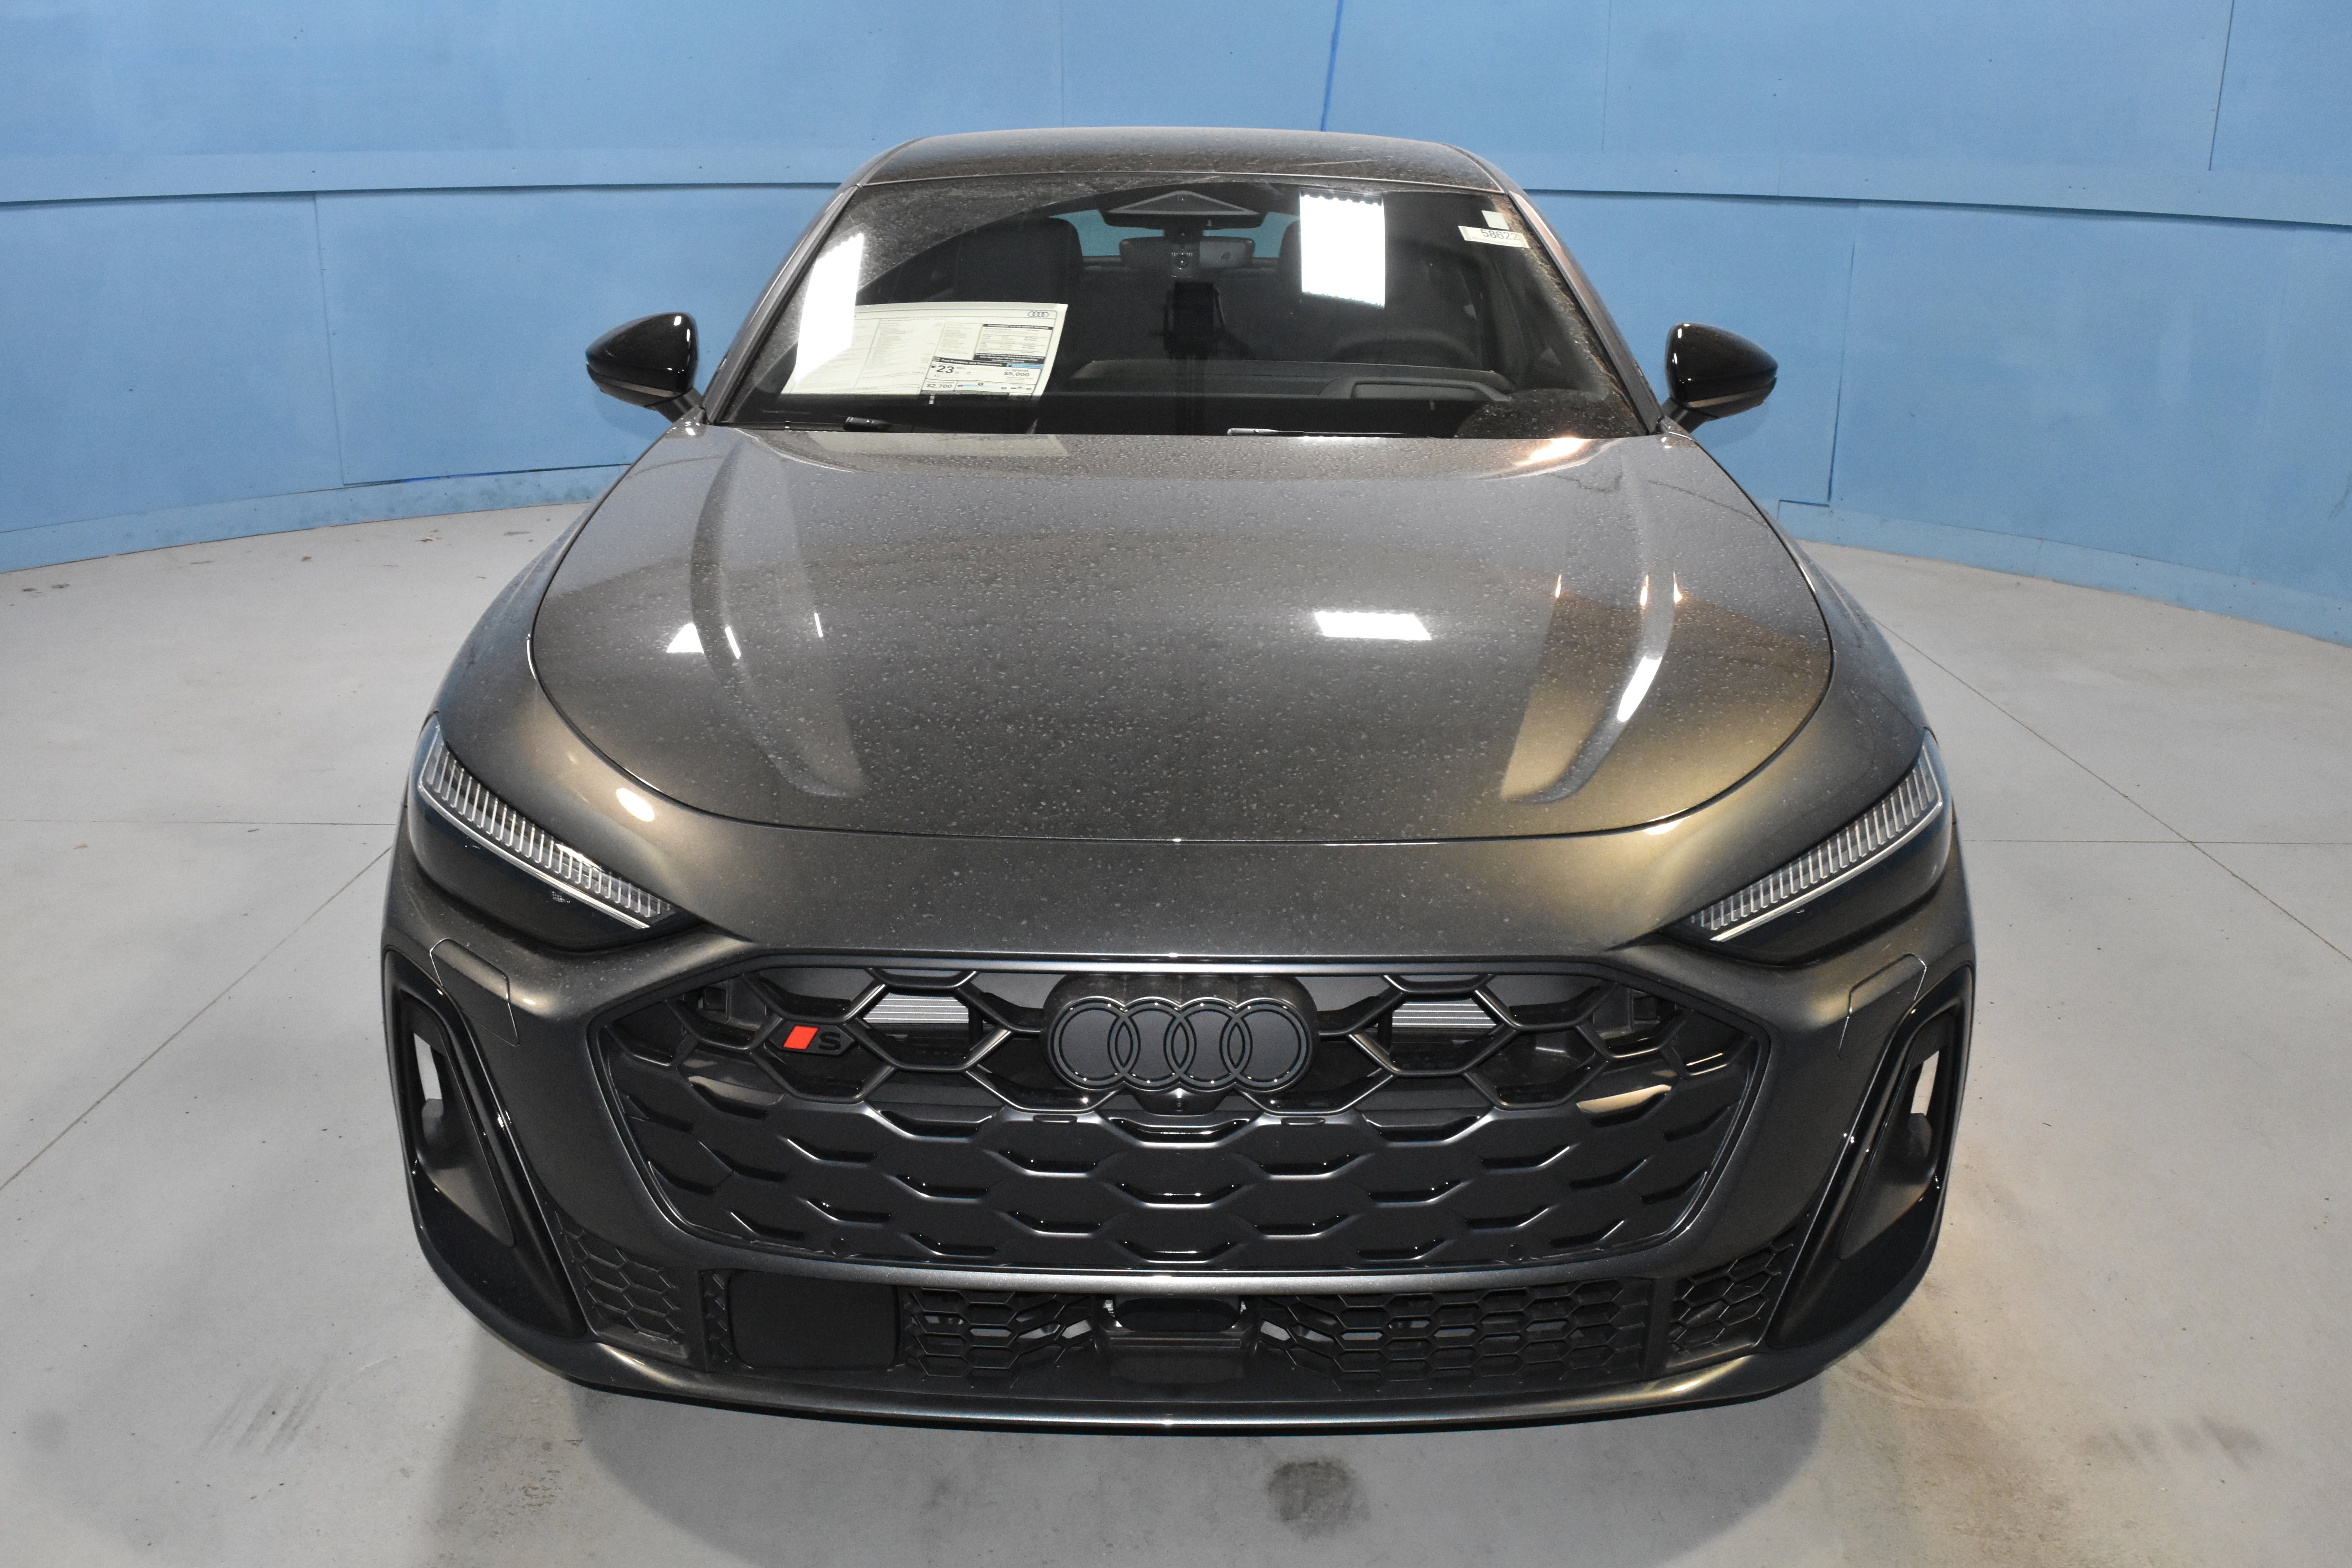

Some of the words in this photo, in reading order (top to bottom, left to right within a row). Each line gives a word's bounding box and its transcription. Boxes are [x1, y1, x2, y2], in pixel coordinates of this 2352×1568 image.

[1481, 229, 1521, 241] 58622
[936, 365, 954, 373] 23
[818, 1031, 841, 1050] S
